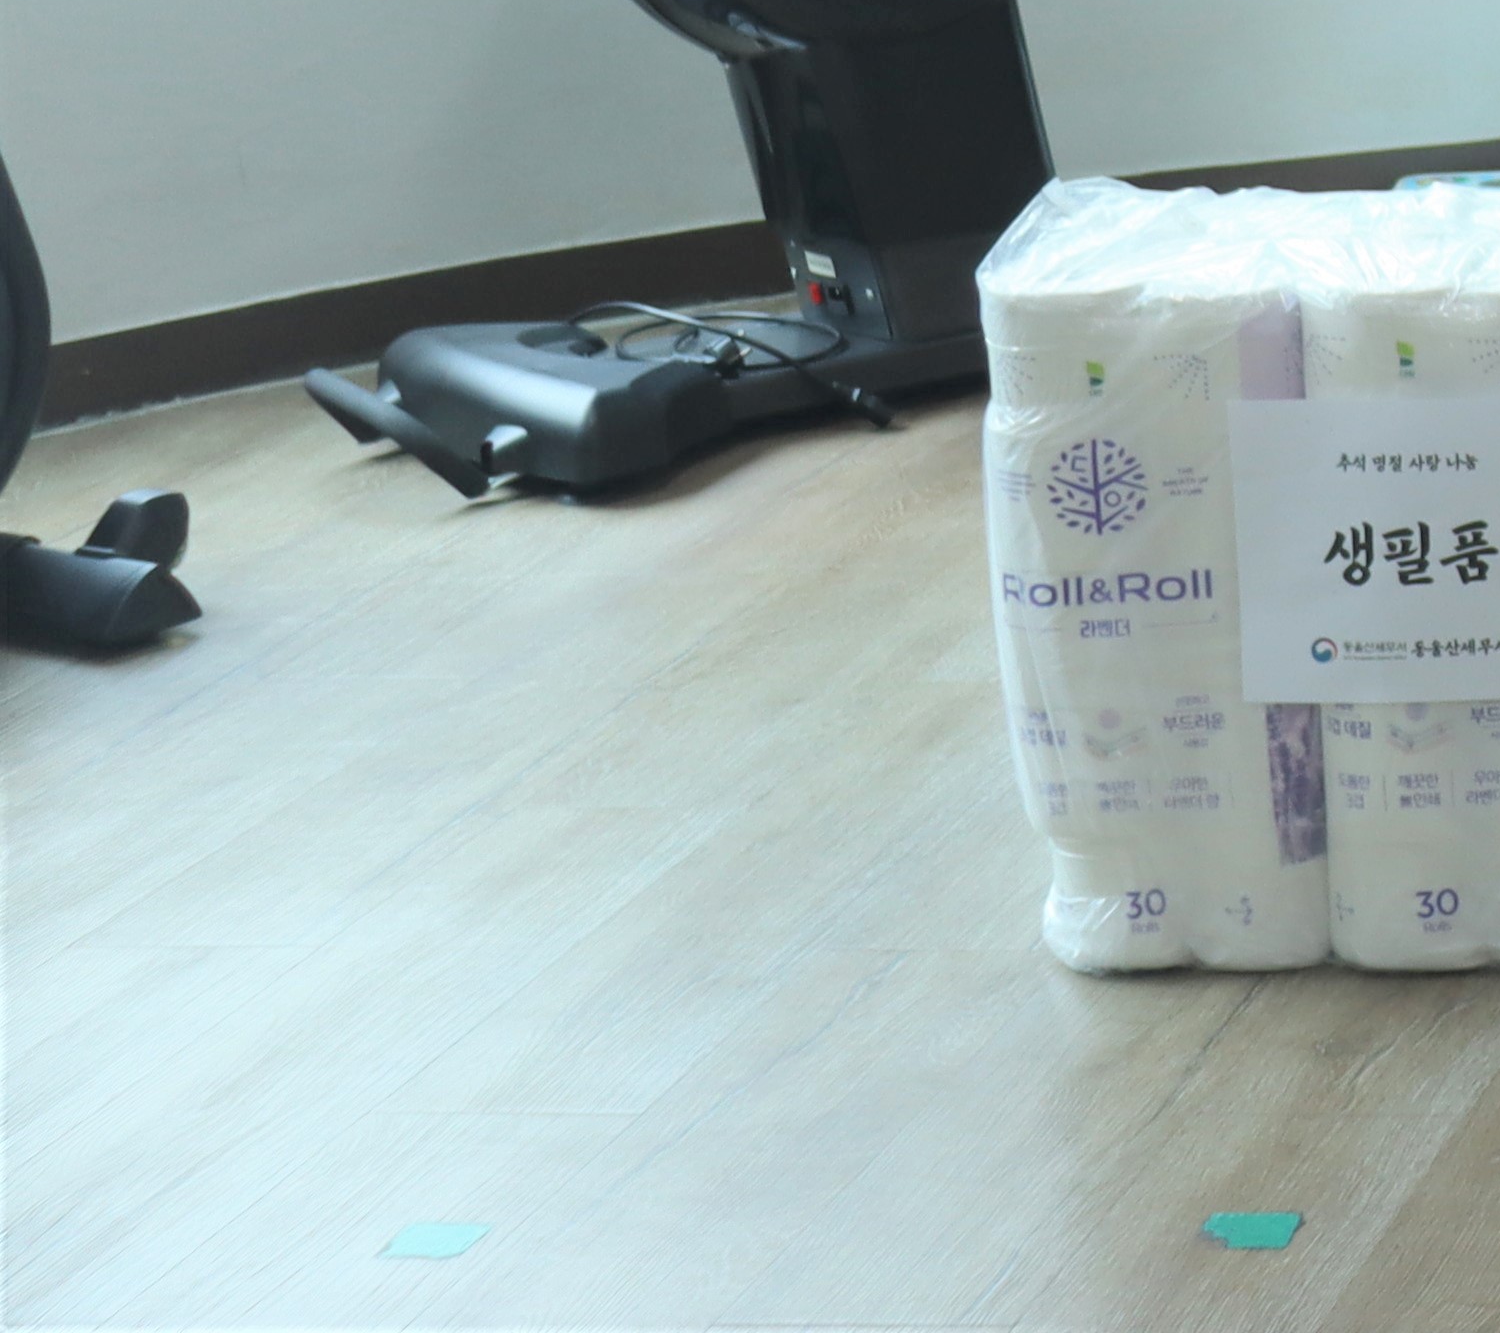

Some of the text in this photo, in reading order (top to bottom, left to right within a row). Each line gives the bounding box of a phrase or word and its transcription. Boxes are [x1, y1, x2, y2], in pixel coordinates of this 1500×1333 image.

[1336, 452, 1479, 473] 추석 명절 사랑 나눔
[1323, 519, 1500, 587] 생필품
[1002, 568, 1213, 608] Roll&Roll
[1080, 618, 1131, 639] 라벤더
[1126, 888, 1166, 920] 30
[1415, 888, 1460, 919] 30
